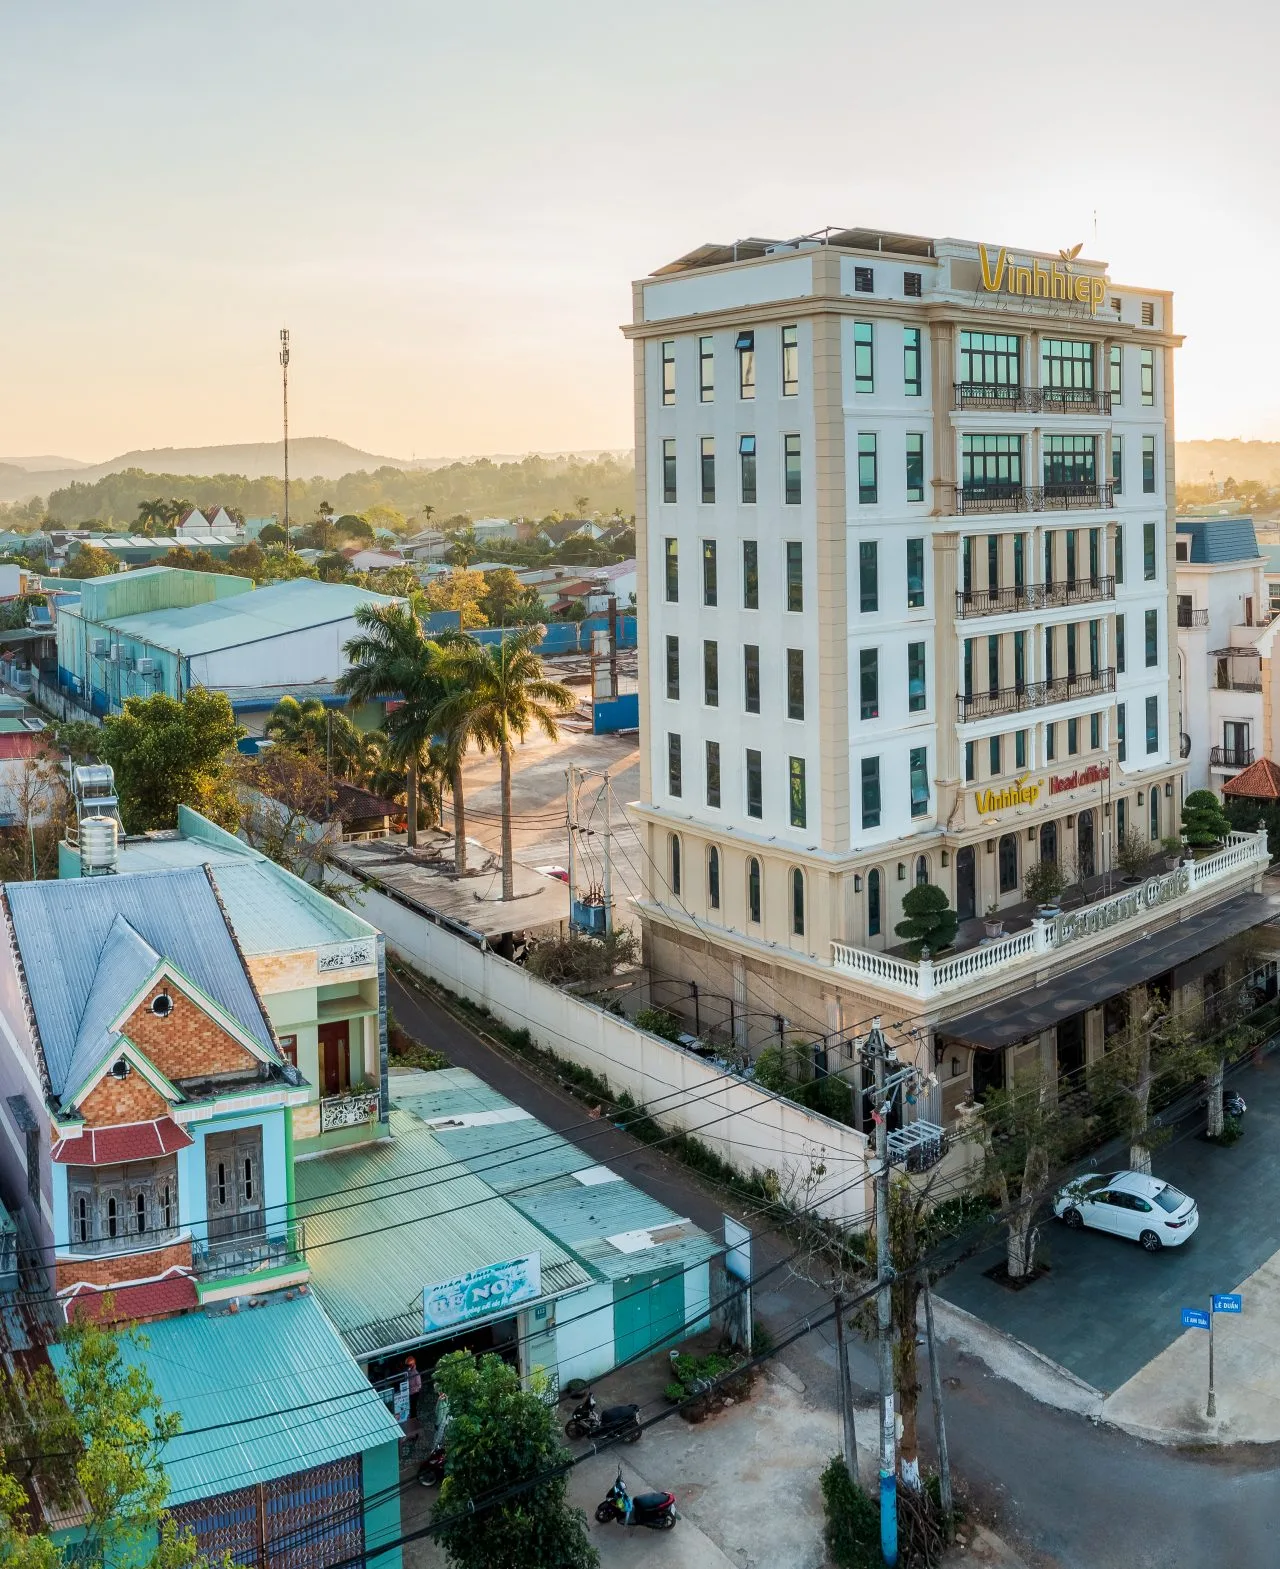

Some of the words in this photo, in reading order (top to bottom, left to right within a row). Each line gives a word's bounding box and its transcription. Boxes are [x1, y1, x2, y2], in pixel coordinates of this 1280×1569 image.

[978, 242, 1105, 315] Vinhhiep
[1049, 770, 1078, 796] Head
[1078, 764, 1109, 787] office
